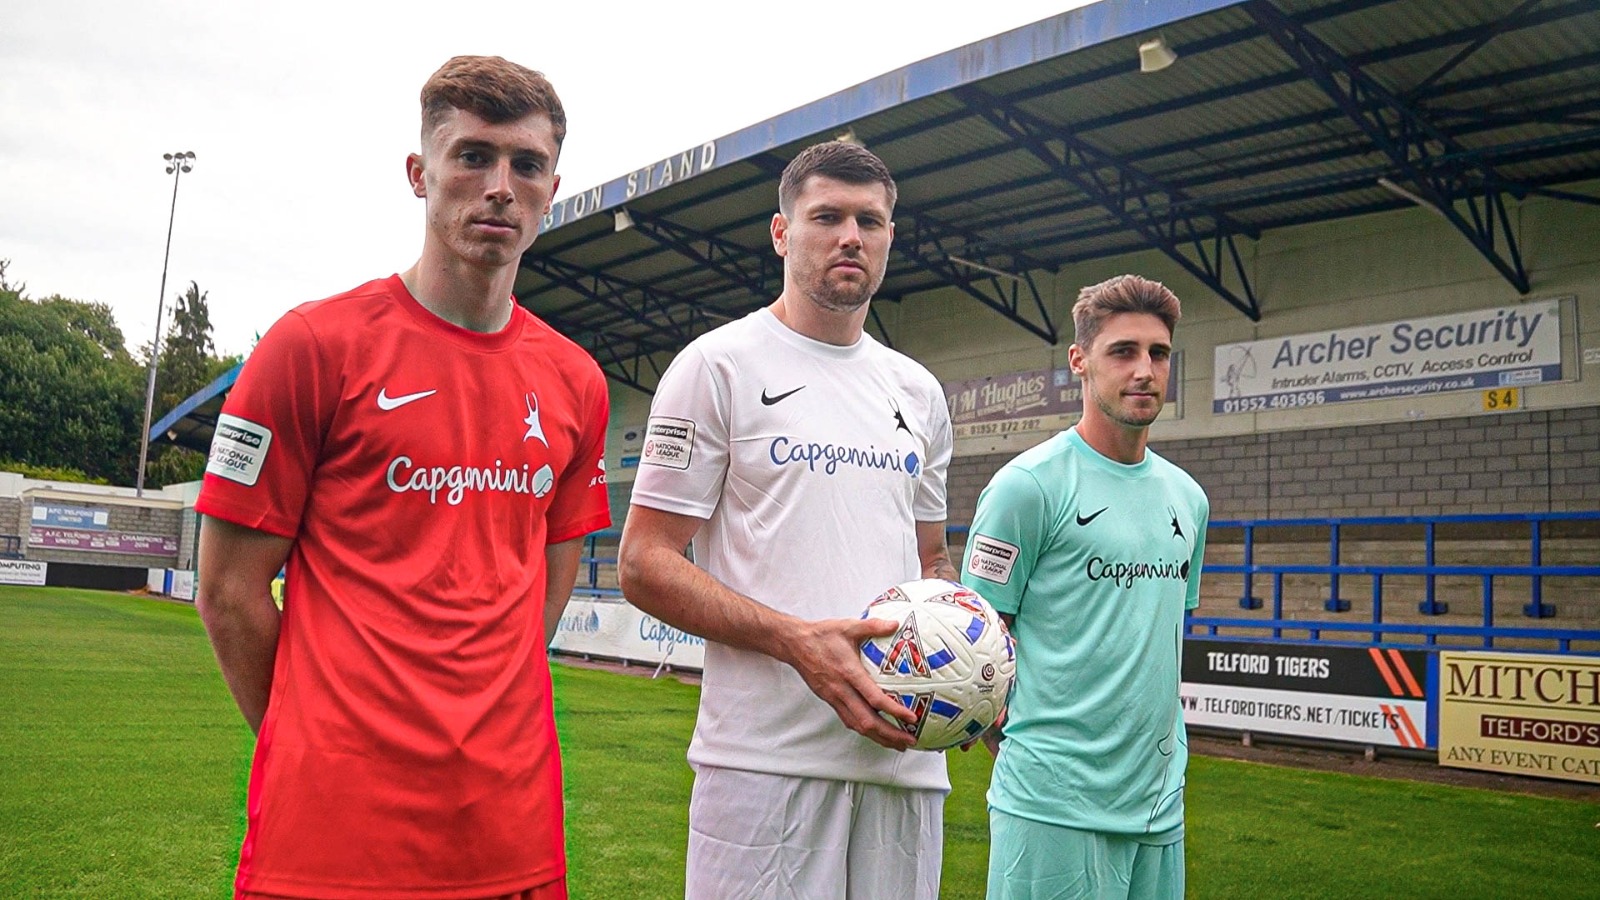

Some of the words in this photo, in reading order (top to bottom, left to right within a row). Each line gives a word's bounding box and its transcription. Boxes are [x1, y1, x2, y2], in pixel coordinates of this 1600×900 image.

[626, 140, 716, 198] STAND
[1272, 333, 1381, 369] Archer
[1390, 310, 1543, 354] Security
[1271, 374, 1319, 389] Intruder
[1321, 370, 1370, 383] Alarms,
[1373, 362, 1414, 379] CCTV,
[1420, 359, 1474, 374] Access
[1478, 349, 1533, 367] Control
[981, 375, 1046, 413] Hughes
[1223, 397, 1266, 413] 01952
[1271, 391, 1326, 408] 403696
[1487, 391, 1498, 408] S
[1502, 390, 1513, 407] 4
[655, 443, 685, 453] NATIONAL
[656, 449, 680, 458] LEAGUE
[770, 436, 903, 475] Capgemini
[1087, 556, 1181, 590] Capgemini
[1207, 651, 1269, 675] TELFORD
[1275, 656, 1330, 679] TIGERS
[1446, 663, 1600, 706] MITCH
[1484, 718, 1599, 745] TELFORD'S
[1447, 746, 1485, 762] ANY
[1490, 750, 1557, 770] EVENT
